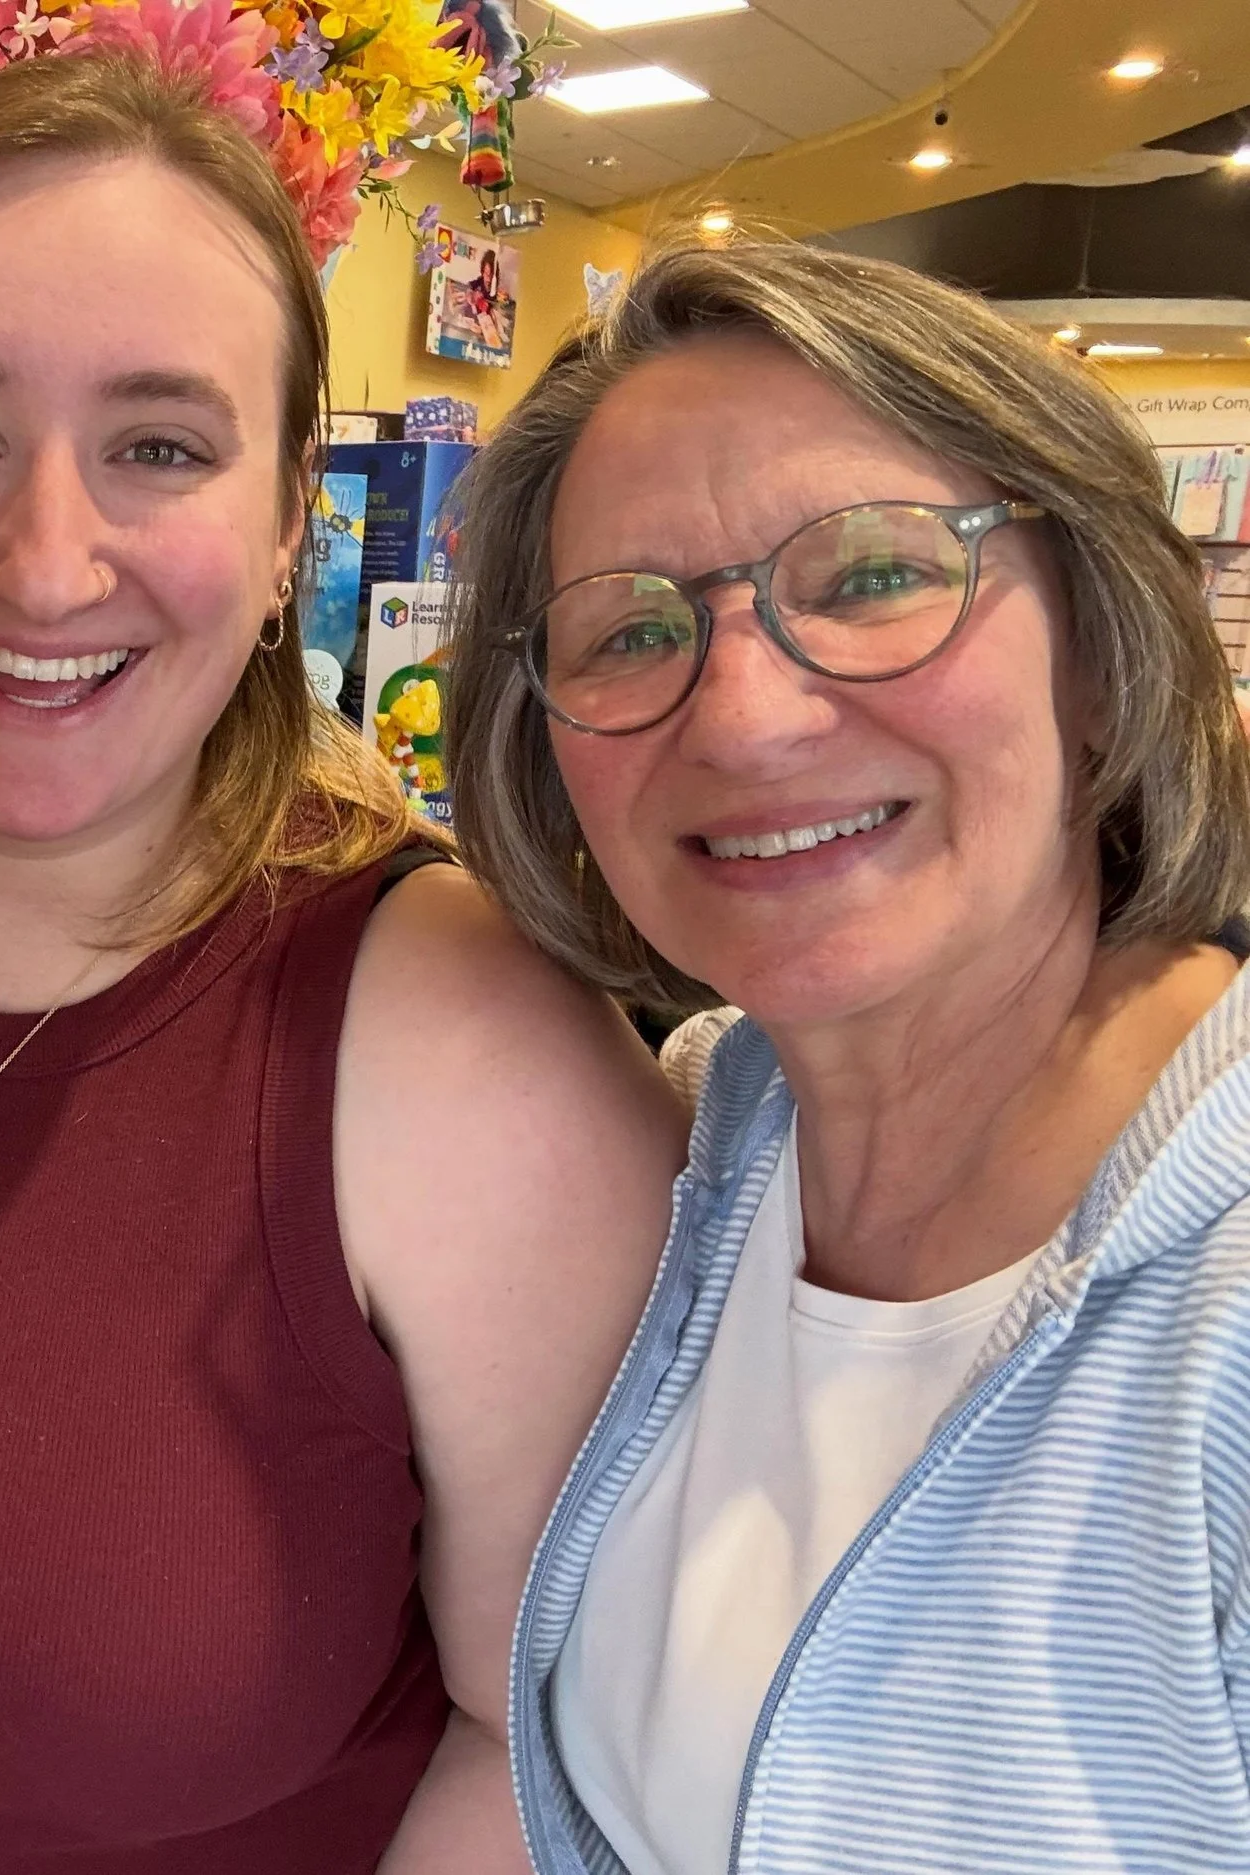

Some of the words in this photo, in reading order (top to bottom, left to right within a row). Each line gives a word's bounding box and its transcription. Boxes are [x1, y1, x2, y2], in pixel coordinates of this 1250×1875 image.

[1137, 399, 1163, 413] Gift
[1168, 399, 1207, 413] Wrap
[400, 452, 418, 468] 8+
[432, 552, 446, 581] GR
[412, 601, 449, 613] Learn
[411, 613, 442, 625] Reso
